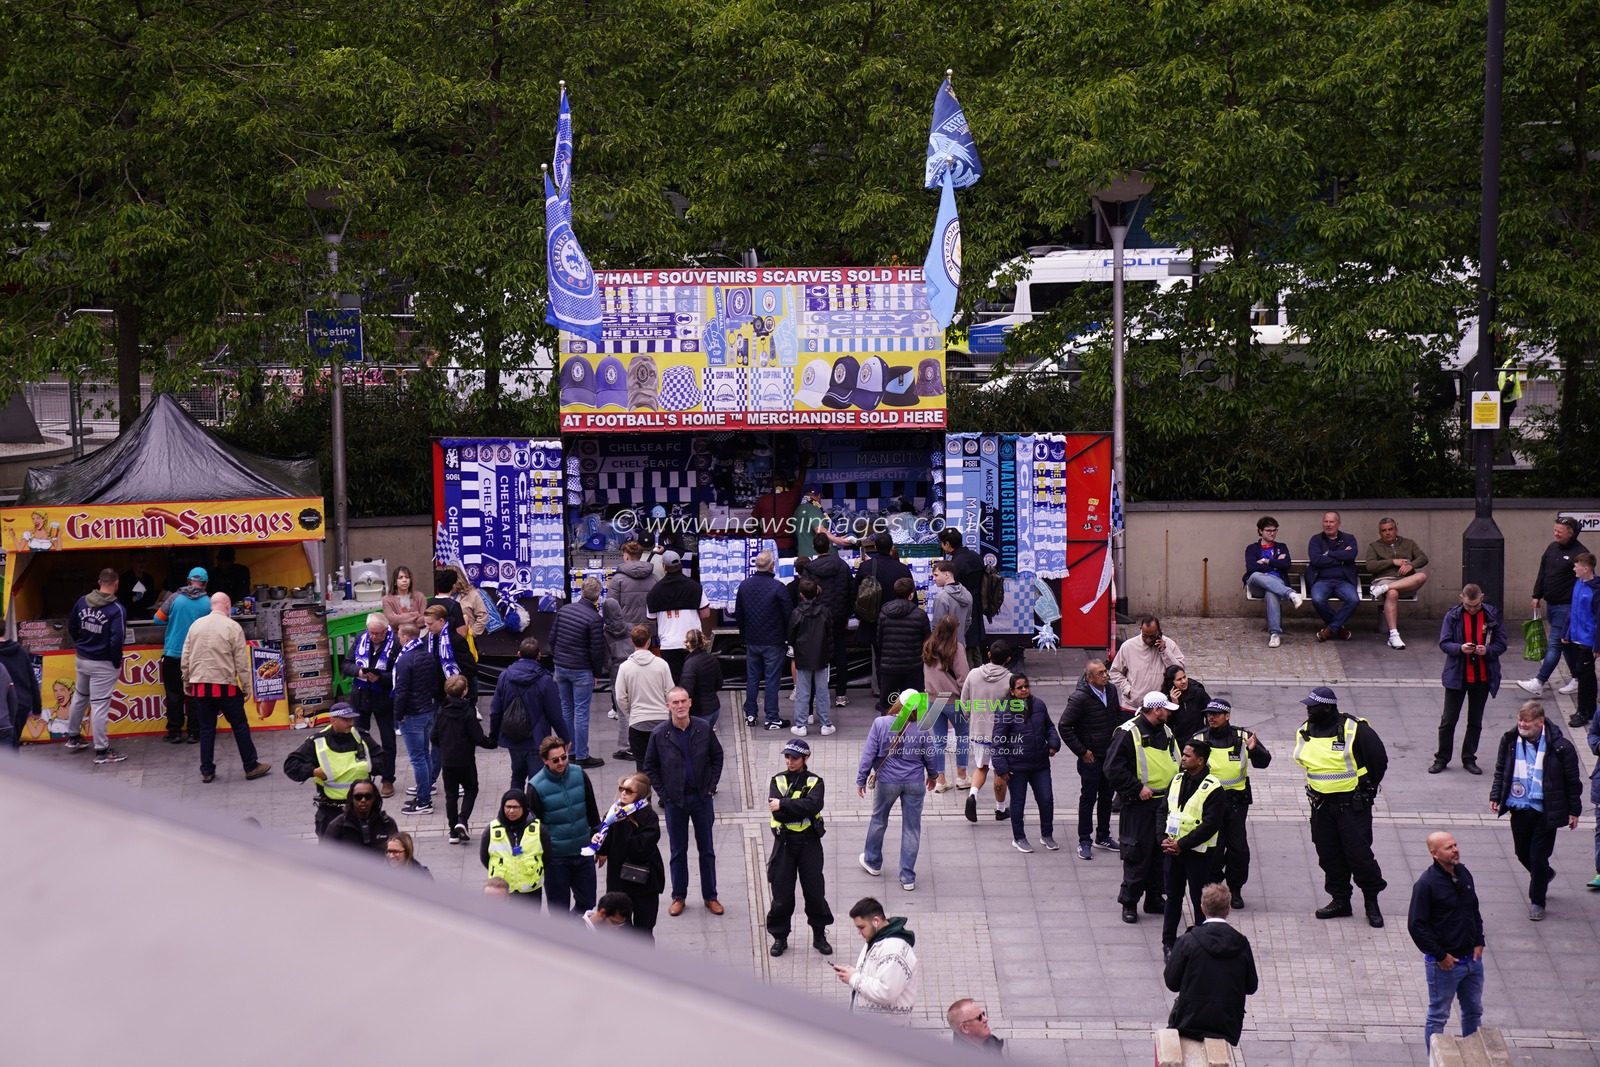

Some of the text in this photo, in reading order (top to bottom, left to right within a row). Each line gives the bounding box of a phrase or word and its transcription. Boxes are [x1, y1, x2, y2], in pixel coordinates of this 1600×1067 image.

[658, 271, 758, 285] SOUVENIRS
[762, 269, 842, 283] SCARVES
[846, 269, 893, 282] SOLD
[831, 313, 911, 321] CITY
[313, 326, 356, 337] Meeting
[626, 329, 672, 337] BLUES
[831, 327, 911, 335] CITY
[563, 414, 582, 427] AT
[589, 413, 678, 427] FOOTBALL'S
[682, 413, 726, 426] HOME
[747, 411, 856, 425] MERCHANDISE
[860, 411, 899, 424] SOLD
[903, 410, 944, 423] HERE
[608, 443, 682, 453] CHELSEA FC
[816, 470, 910, 481] MANCHESTER CITY
[985, 468, 994, 514] MANCHESTER
[1001, 461, 1017, 541] MANCHESTER
[500, 475, 512, 551] CHELSEA FC
[66, 508, 295, 541] German Sausages
[448, 506, 463, 556] CHELS
[749, 538, 758, 578] BLUE
[1002, 545, 1017, 569] CITY
[78, 608, 109, 625] CHELSEA
[81, 621, 103, 634] LONDON
